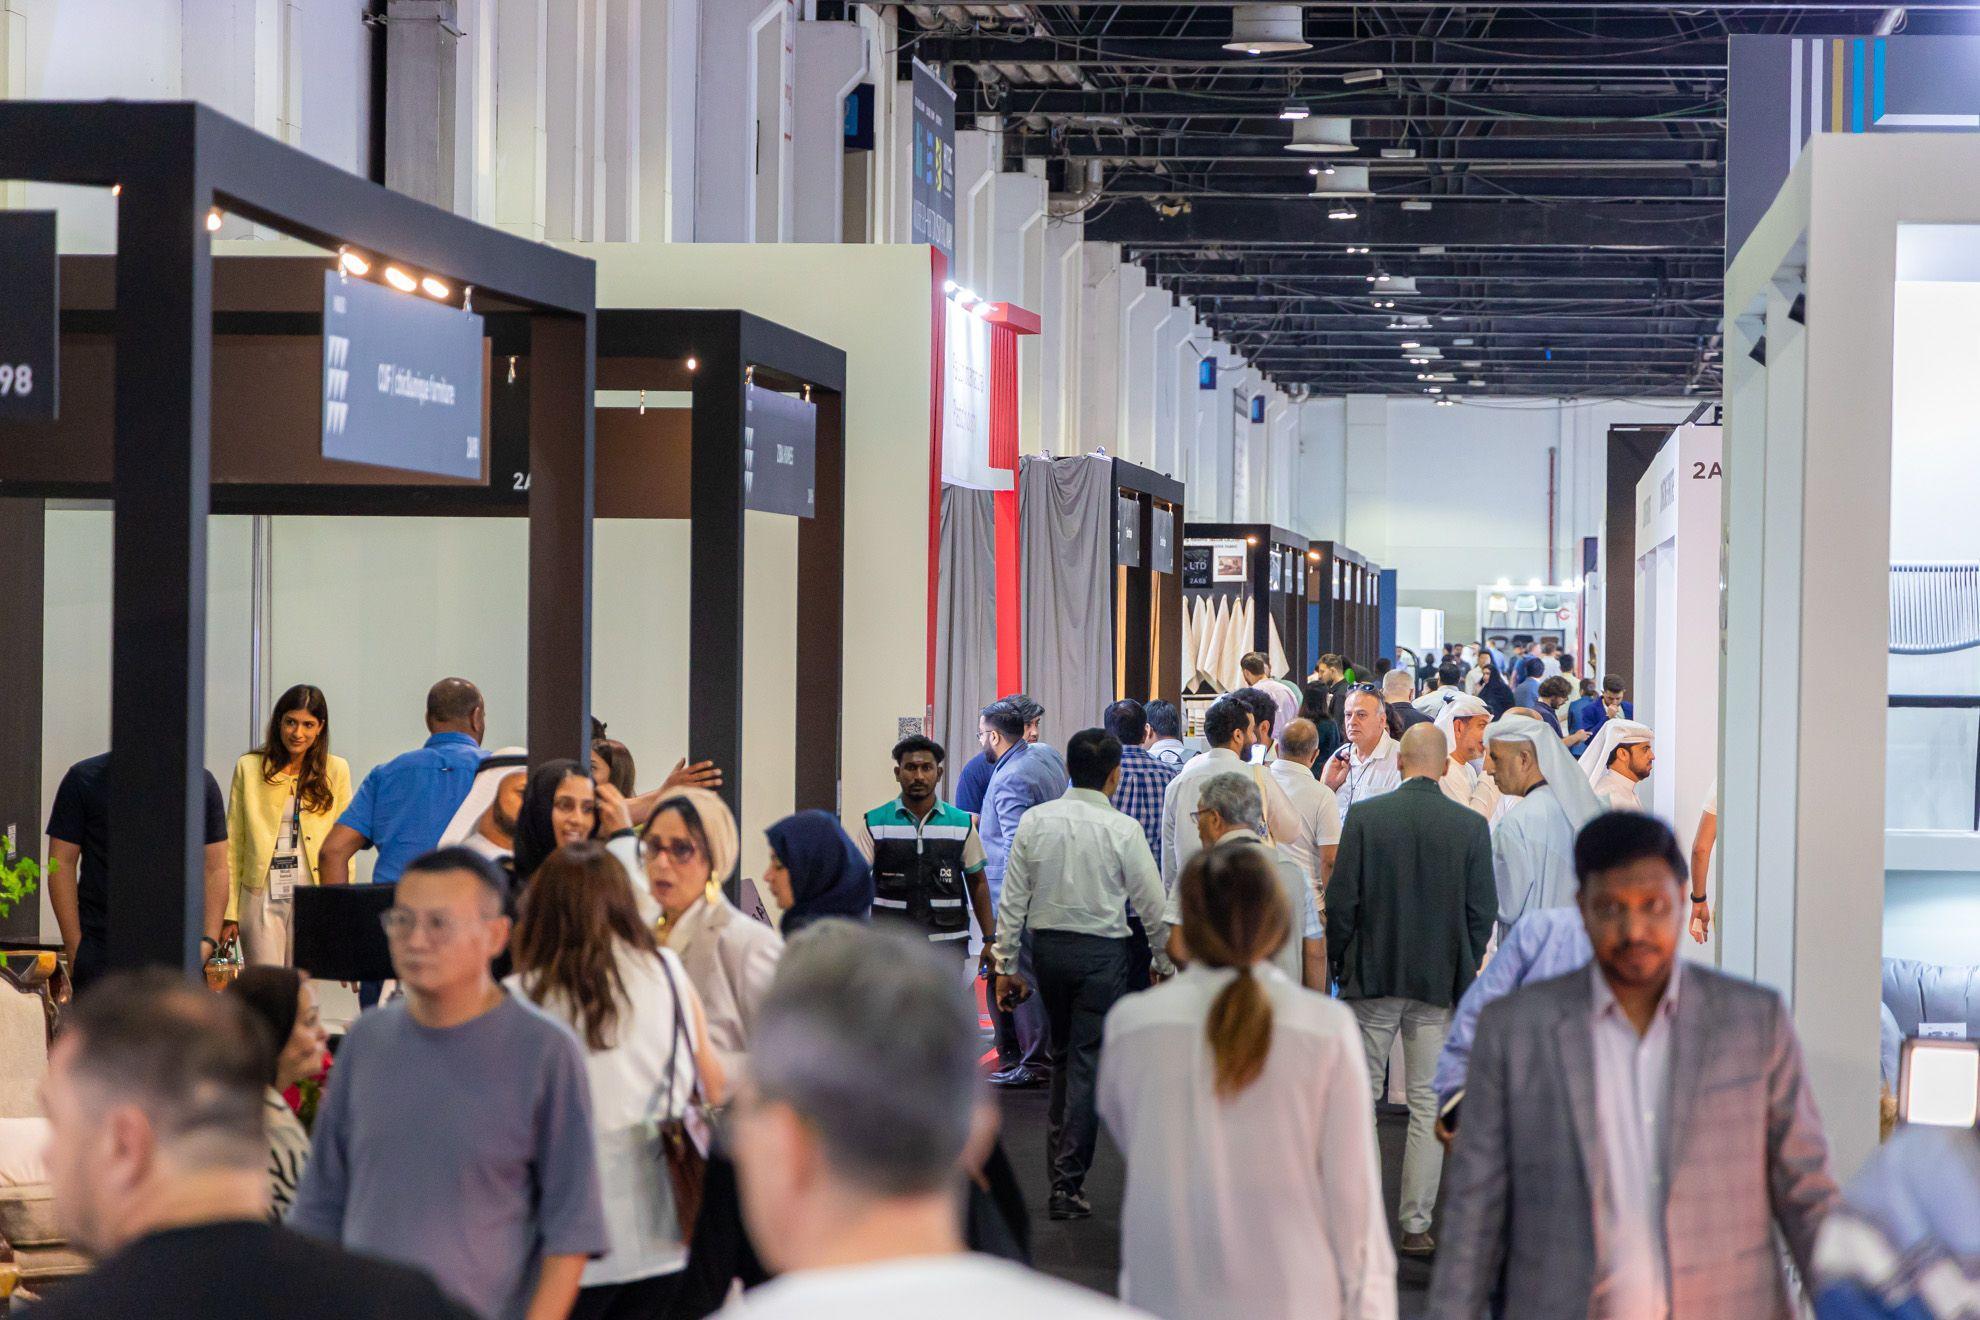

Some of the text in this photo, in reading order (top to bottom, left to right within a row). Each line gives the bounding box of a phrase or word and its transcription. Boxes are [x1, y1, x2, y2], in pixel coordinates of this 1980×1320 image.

[0, 365, 33, 395] 98
[1693, 462, 1722, 479] 2A
[1190, 561, 1206, 570] LTD
